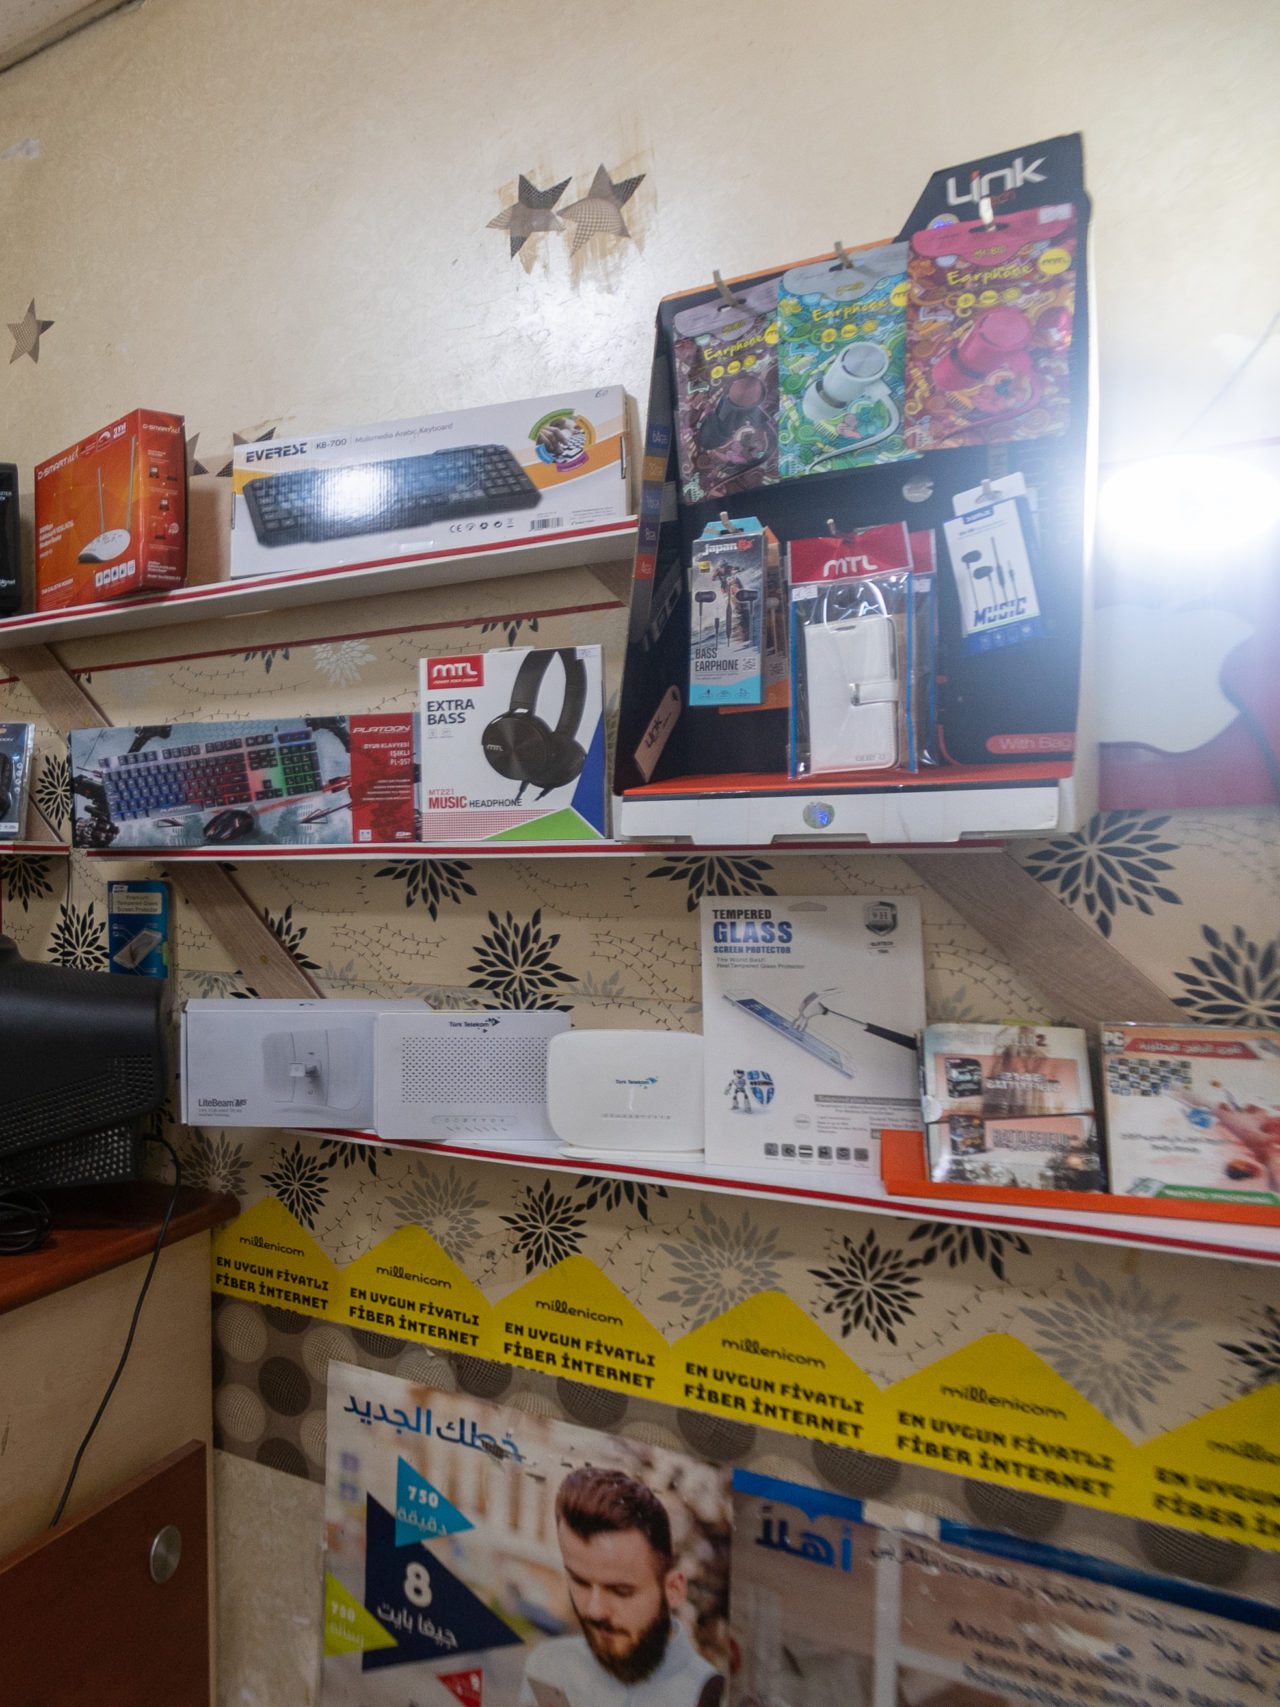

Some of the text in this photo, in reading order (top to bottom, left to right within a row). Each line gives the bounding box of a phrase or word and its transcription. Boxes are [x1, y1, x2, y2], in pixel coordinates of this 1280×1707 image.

[946, 263, 1033, 285] Earphone
[812, 300, 887, 321] Earphone
[703, 334, 765, 361] Earphone
[246, 443, 307, 463] EVEREST
[316, 438, 347, 449] KB-700
[419, 422, 453, 436] Keyboard
[695, 648, 717, 659] BASS
[695, 660, 739, 672] EARPHONE
[427, 699, 475, 712] EXTRA
[353, 725, 411, 734] PLATOON
[427, 712, 466, 725] BASS
[998, 735, 1073, 753] With Bag
[428, 796, 522, 809] MUSIC HEADPHONE
[713, 909, 771, 919] TEMPERED
[713, 921, 793, 943] GLASS
[713, 946, 791, 954] SCREEN PROTECTOR
[198, 1098, 234, 1107] LiteBeam
[240, 1236, 304, 1257] millenicom
[216, 1256, 329, 1291] EN UYGUN FİYATLI
[376, 1265, 451, 1289] millenicom
[216, 1273, 328, 1310] FİBER İNTERNET
[350, 1287, 479, 1326] EN UYGUN FİYATLI
[536, 1299, 623, 1326] millenicom
[349, 1306, 479, 1347] FİBER İNTERNET
[505, 1321, 655, 1367] EN UYGUN FİYATLI
[722, 1338, 826, 1369] millenicom
[504, 1341, 655, 1389] FİBER İNTERNET
[686, 1362, 864, 1414] EN UYGUN FİYATLI
[685, 1383, 864, 1439] FİBER İNTERNET
[940, 1384, 1067, 1421] millenicom
[343, 1395, 432, 1436] الجديد
[898, 1410, 926, 1429] EN
[897, 1432, 1115, 1499] FİBER İNTERNET
[408, 1485, 439, 1508] 750
[404, 1562, 432, 1607] 8
